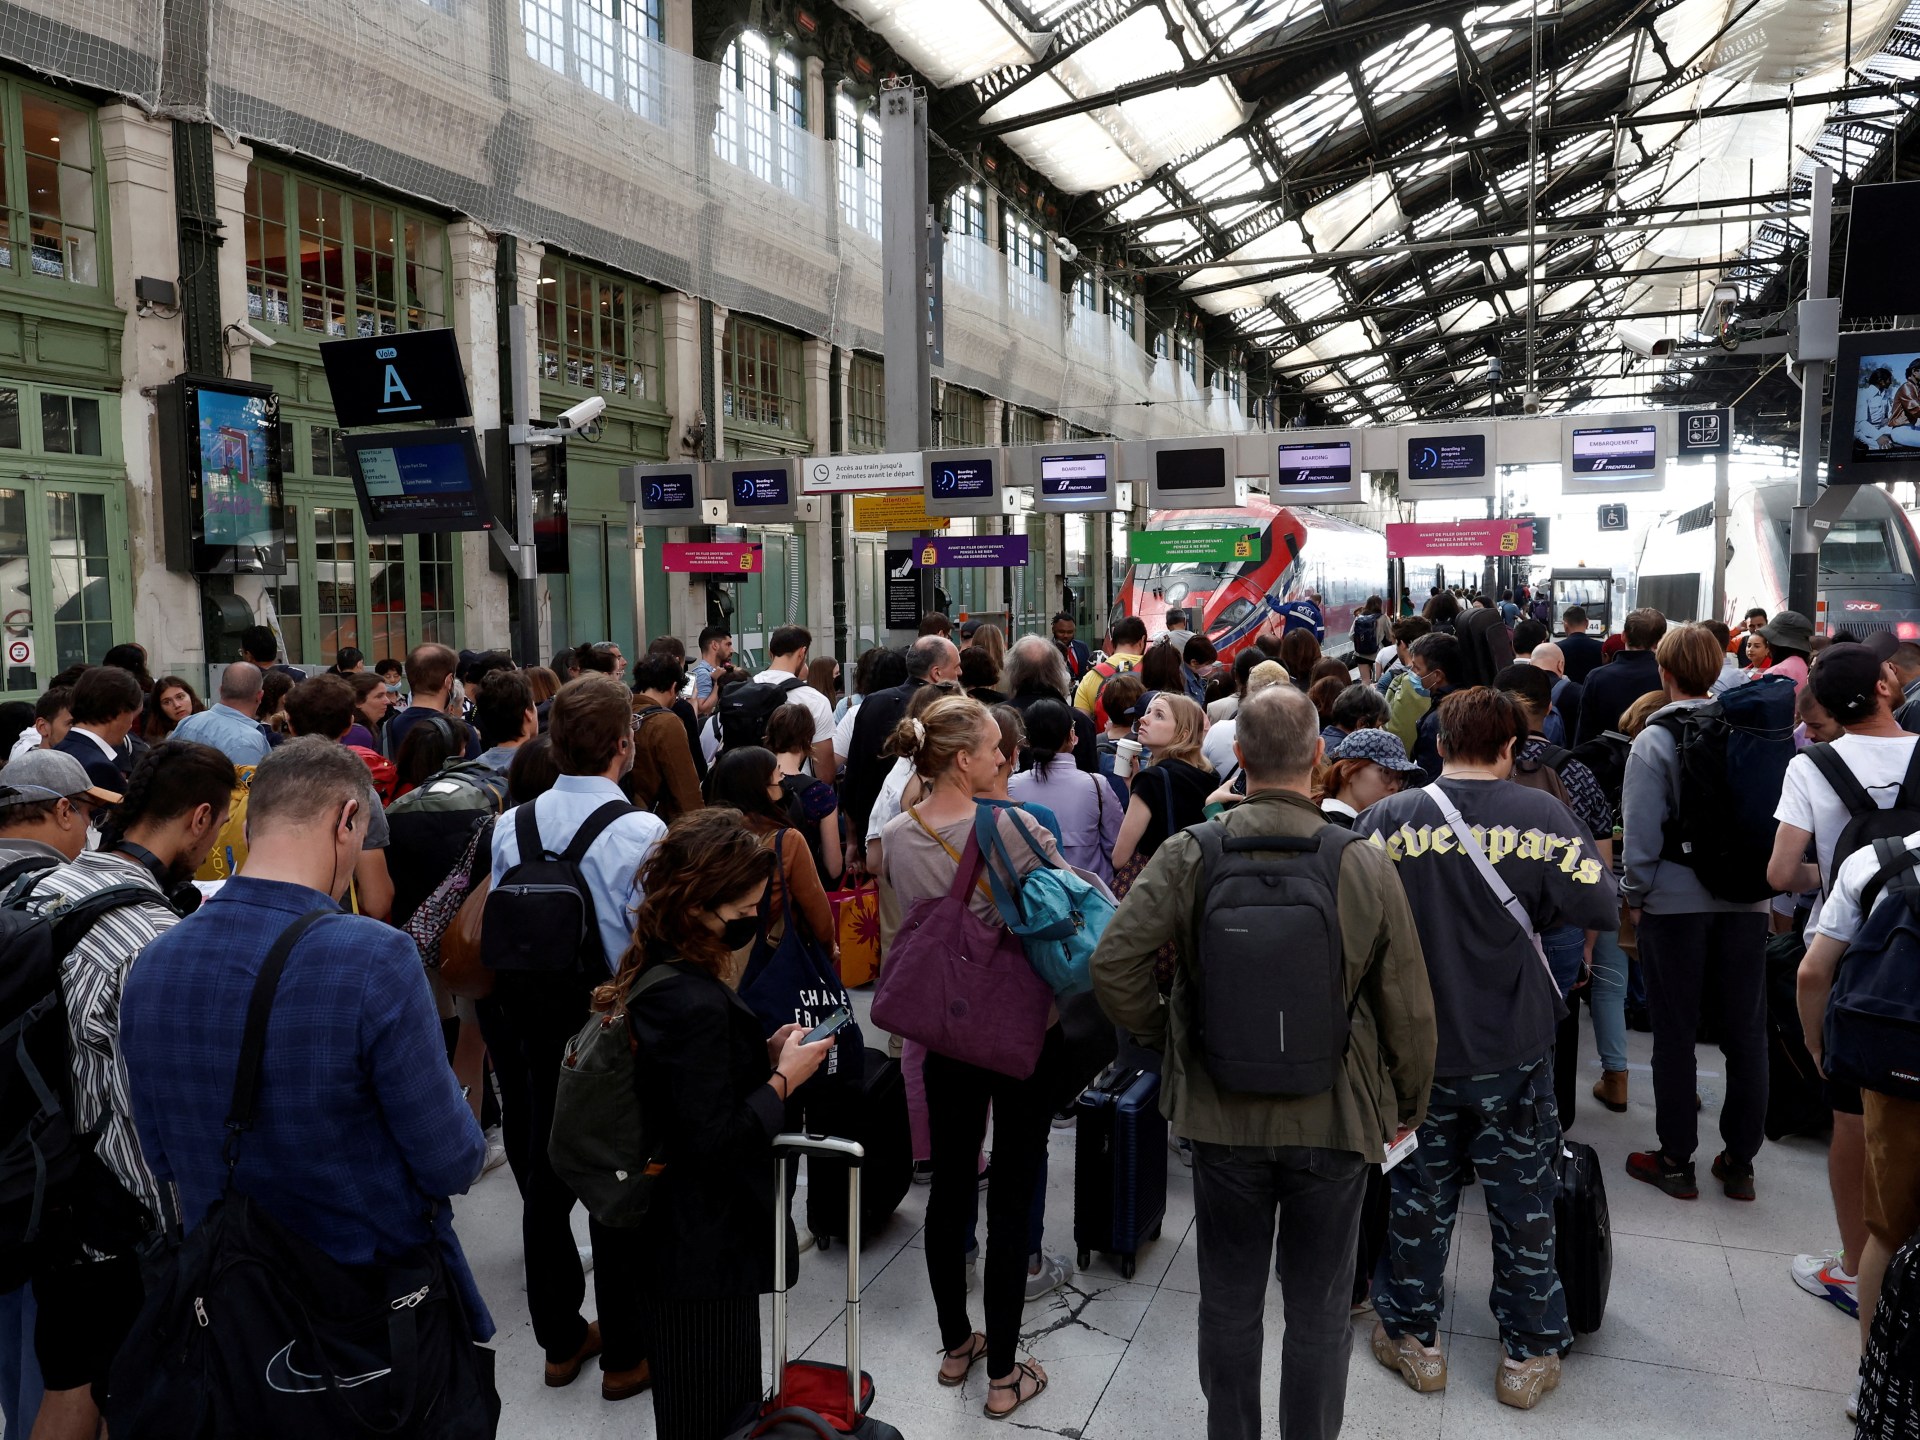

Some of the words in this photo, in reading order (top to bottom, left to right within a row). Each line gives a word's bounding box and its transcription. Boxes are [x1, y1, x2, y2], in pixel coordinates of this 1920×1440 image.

[378, 350, 394, 358] Voie
[383, 364, 412, 403] A
[893, 470, 915, 478] départ
